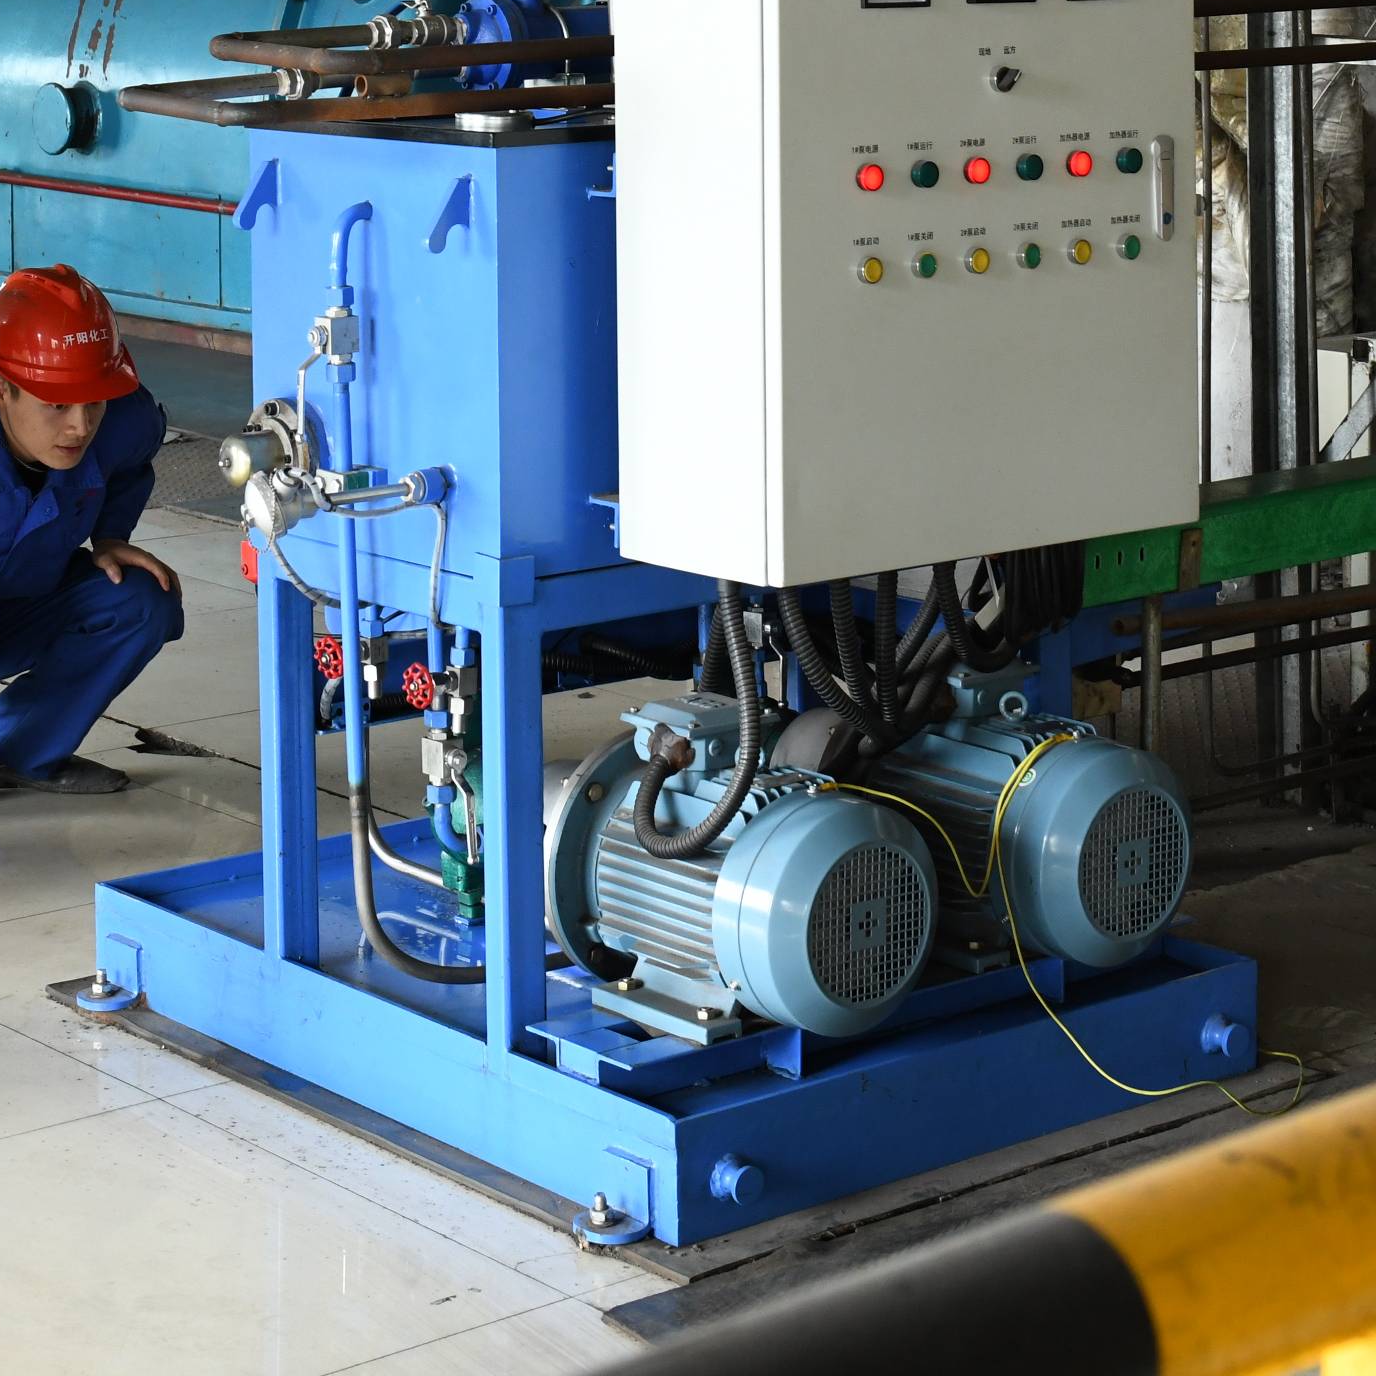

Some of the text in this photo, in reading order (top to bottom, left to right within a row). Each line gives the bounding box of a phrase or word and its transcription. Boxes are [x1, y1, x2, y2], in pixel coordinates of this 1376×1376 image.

[1059, 132, 1090, 142] 加热器电源
[63, 328, 110, 347] 开阳化工
